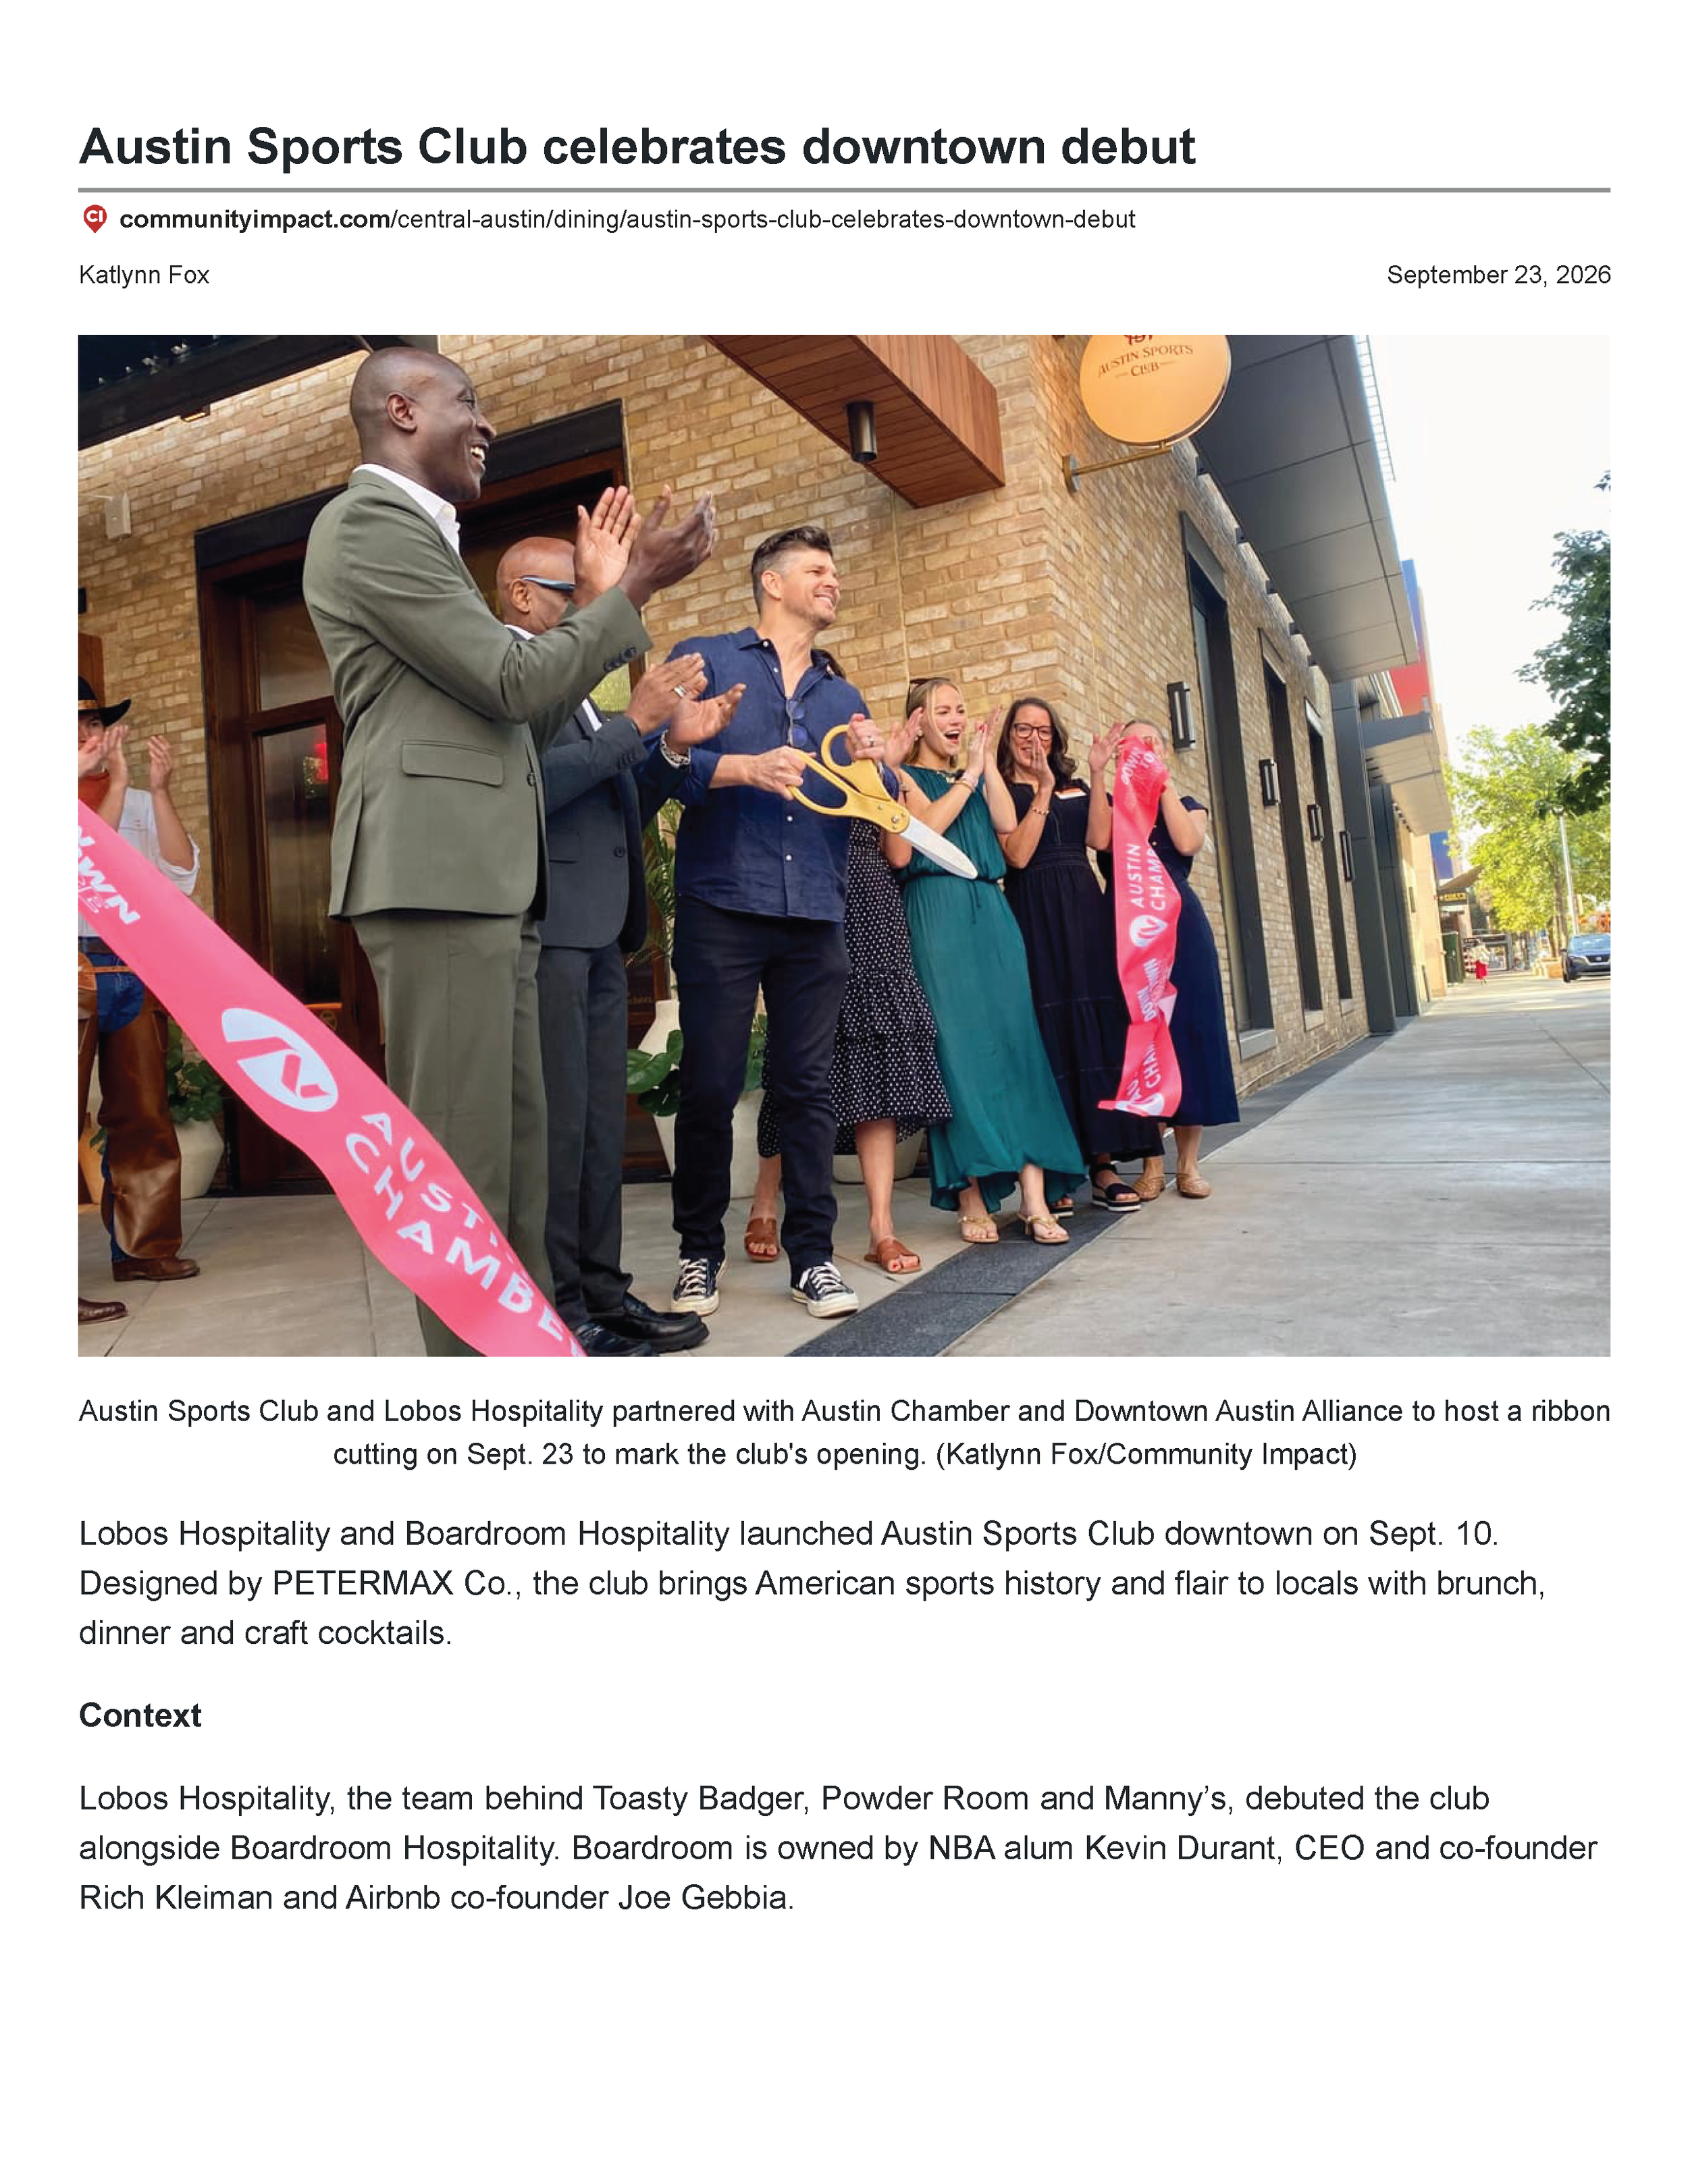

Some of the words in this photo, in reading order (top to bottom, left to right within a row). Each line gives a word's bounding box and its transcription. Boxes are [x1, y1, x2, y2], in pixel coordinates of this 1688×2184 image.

[79, 128, 230, 164] Austin
[248, 127, 402, 174] Sports
[419, 127, 527, 164] Club
[544, 128, 785, 164] celebrates
[803, 128, 1044, 164] downtown
[1062, 128, 1196, 164] debut
[86, 209, 103, 223] CI
[120, 210, 1135, 233] communityimpact.com/central-austin/dining/austin-sports-club-celebrates-downtown-debut
[80, 265, 159, 288] Katlynn
[170, 265, 209, 284] Fox
[1388, 265, 1508, 288] September
[1515, 265, 1546, 287] 23,
[1557, 265, 1610, 284] 2026
[1099, 351, 1138, 377] AUSTIN
[1143, 345, 1193, 357] SPORTS
[1131, 363, 1159, 376] CLUB
[1126, 844, 1144, 908] AUSTIN
[361, 1112, 517, 1264] AUST
[345, 1134, 586, 1356] CHAMBE
[79, 1400, 157, 1421] Austin
[169, 1400, 250, 1427] Sports
[260, 1400, 318, 1421] Club
[327, 1400, 373, 1421] and
[386, 1400, 460, 1421] Lobos
[473, 1400, 603, 1427] Hospitality
[614, 1400, 734, 1427] partnered
[743, 1400, 793, 1421] with
[801, 1400, 880, 1421] Austin
[891, 1400, 1010, 1421] Chamber
[1019, 1400, 1064, 1421] and
[1076, 1400, 1207, 1421] Downtown
[1215, 1400, 1294, 1421] Austin
[1302, 1400, 1402, 1421] Alliance
[1413, 1400, 1435, 1421] to
[1446, 1400, 1499, 1421] host
[1508, 1405, 1521, 1421] a
[1533, 1400, 1609, 1421] ribbon
[334, 1443, 417, 1470] cutting
[427, 1448, 456, 1464] on
[468, 1443, 531, 1470] Sept.
[543, 1443, 573, 1464] 23
[583, 1443, 605, 1464] to
[616, 1443, 679, 1464] mark
[688, 1443, 726, 1464] the
[737, 1443, 807, 1464] club's
[818, 1443, 925, 1470] opening.
[937, 1443, 1040, 1470] (Katlynn
[1053, 1443, 1252, 1470] Fox/Community
[1263, 1443, 1356, 1470] Impact)
[81, 1521, 167, 1545] Lobos
[181, 1521, 330, 1551] Hospitality
[341, 1521, 393, 1545] and
[407, 1521, 564, 1545] Boardroom
[580, 1521, 730, 1551] Hospitality
[741, 1521, 872, 1545] launched
[881, 1521, 971, 1545] Austin
[984, 1520, 1076, 1551] Sports
[1089, 1520, 1154, 1545] Club
[1165, 1521, 1311, 1545] downtown
[1324, 1526, 1357, 1545] on
[1370, 1520, 1442, 1551] Sept.
[1458, 1521, 1497, 1545] 10.
[81, 1570, 217, 1601] Designed
[230, 1570, 262, 1601] by
[275, 1570, 454, 1595] PETERMAX
[465, 1570, 521, 1600] Co.,
[533, 1570, 578, 1595] the
[589, 1570, 648, 1595] club
[660, 1570, 747, 1601] brings
[755, 1570, 894, 1595] American
[906, 1571, 994, 1601] sports
[1006, 1570, 1101, 1601] history
[1112, 1570, 1164, 1595] and
[1175, 1570, 1229, 1595] flair
[1238, 1571, 1264, 1595] to
[1277, 1570, 1358, 1595] locals
[1368, 1570, 1425, 1595] with
[1438, 1570, 1543, 1599] brunch,
[80, 1620, 171, 1644] dinner
[181, 1620, 233, 1644] and
[246, 1620, 308, 1644] craft
[319, 1620, 450, 1644] cocktails.
[80, 1702, 201, 1727] Context
[81, 1786, 167, 1809] Lobos
[181, 1786, 334, 1816] Hospitality,
[348, 1786, 392, 1809] the
[402, 1786, 472, 1809] team
[486, 1786, 582, 1809] behind
[593, 1786, 688, 1816] Toasty
[700, 1786, 808, 1816] Badger,
[823, 1786, 933, 1809] Powder
[945, 1786, 1028, 1809] Room
[1041, 1786, 1093, 1809] and
[1246, 1786, 1363, 1809] debuted
[1375, 1786, 1419, 1809] the
[1430, 1786, 1489, 1809] club
[80, 1835, 219, 1866] alongside
[232, 1835, 390, 1859] Boardroom
[405, 1835, 558, 1866] Hospitality.
[574, 1835, 731, 1859] Boardroom
[747, 1835, 766, 1859] is
[779, 1835, 872, 1859] owned
[886, 1835, 918, 1866] by
[930, 1835, 996, 1859] NBA
[1005, 1835, 1072, 1859] alum
[1087, 1835, 1165, 1859] Kevin
[1179, 1835, 1281, 1865] Durant,
[1296, 1834, 1364, 1860] CEO
[1376, 1835, 1429, 1859] and
[1440, 1835, 1598, 1859] co-founder
[81, 1885, 143, 1909] Rich
[157, 1885, 271, 1909] Kleiman
[284, 1885, 336, 1909] and
[346, 1885, 440, 1909] Airbnb
[451, 1885, 609, 1909] co-founder
[619, 1885, 670, 1909] Joe
[683, 1884, 793, 1909] Gebbia.
